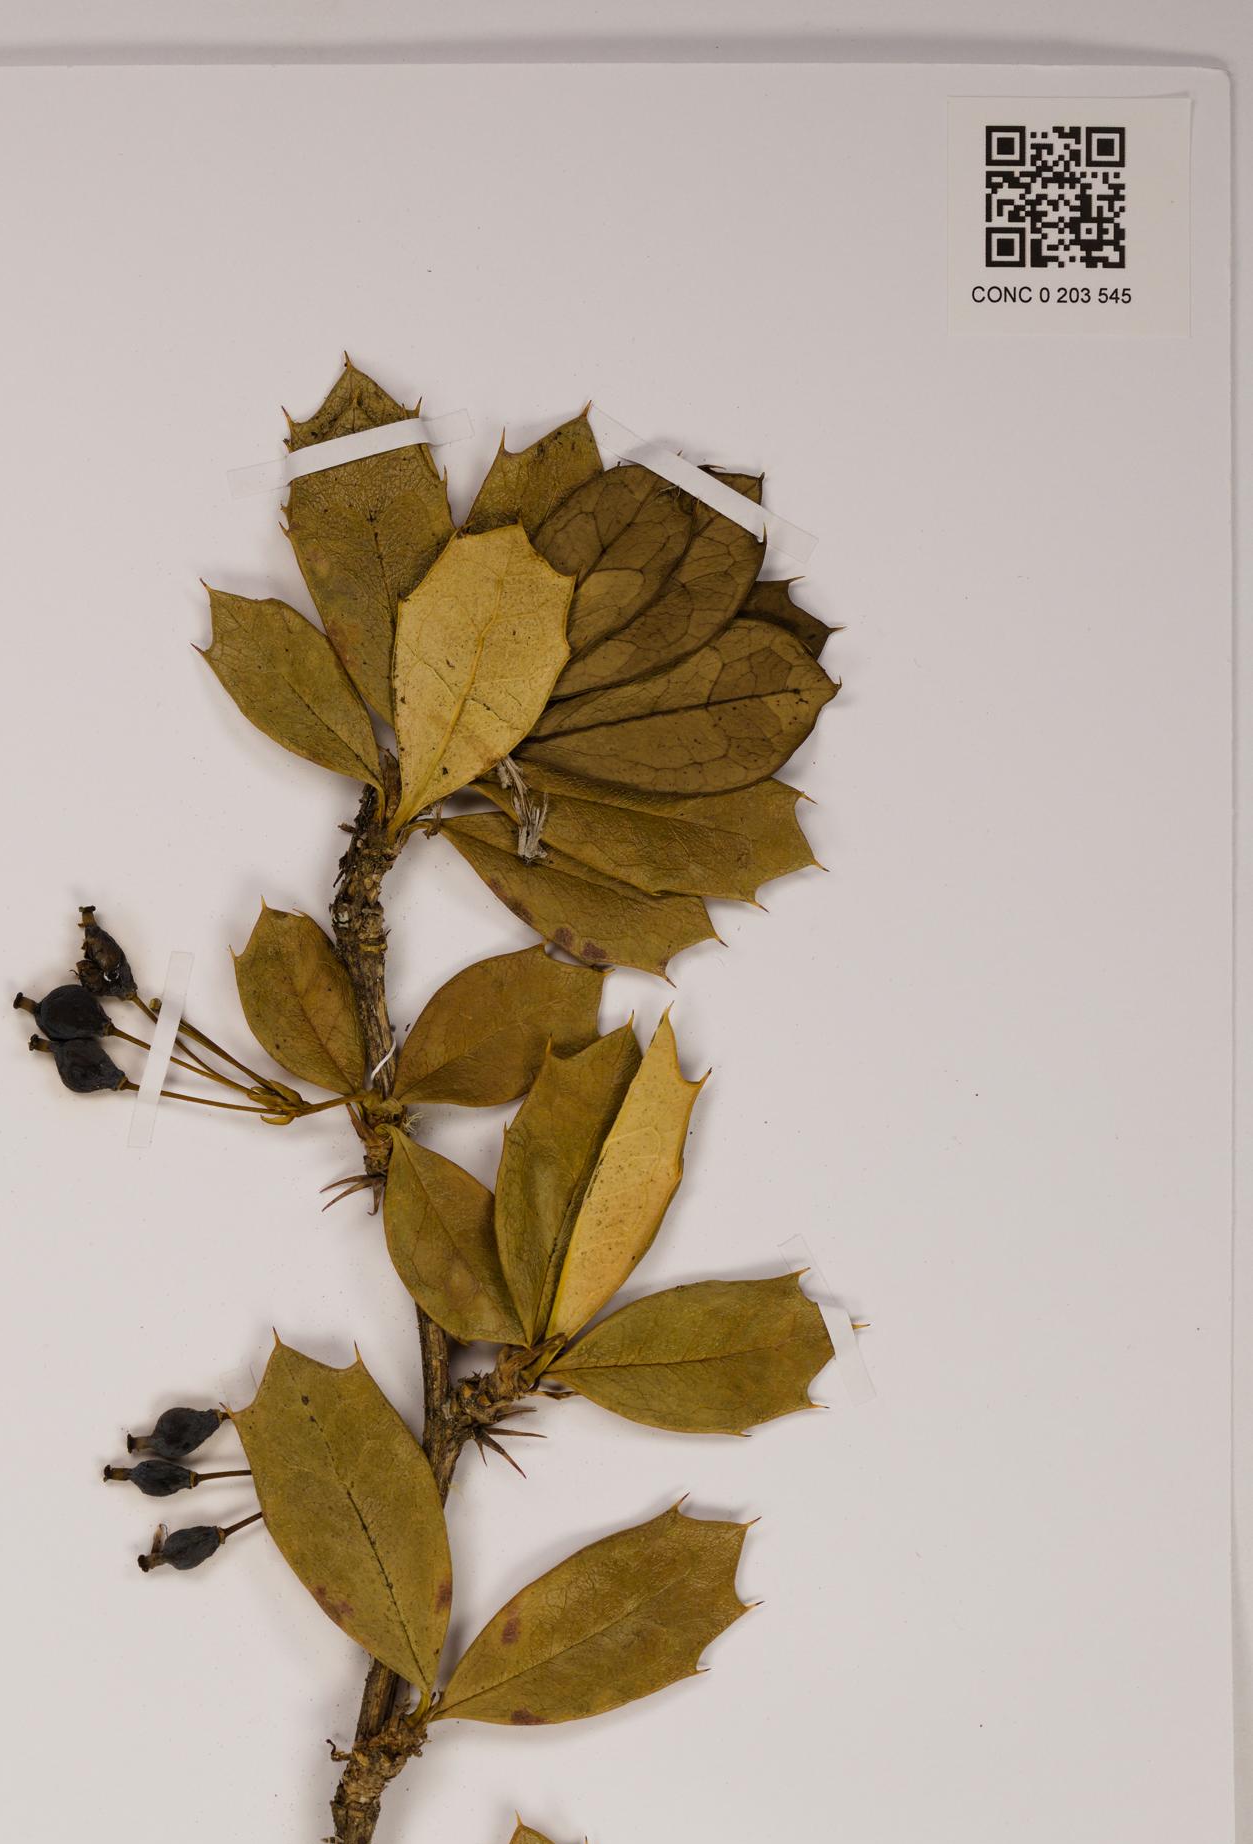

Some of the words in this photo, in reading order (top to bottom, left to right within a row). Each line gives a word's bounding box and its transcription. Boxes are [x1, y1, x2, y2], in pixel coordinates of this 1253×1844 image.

[971, 285, 1033, 304] CONC
[1039, 286, 1051, 304] 0
[1056, 286, 1092, 304] 203
[1097, 287, 1132, 305] 545
